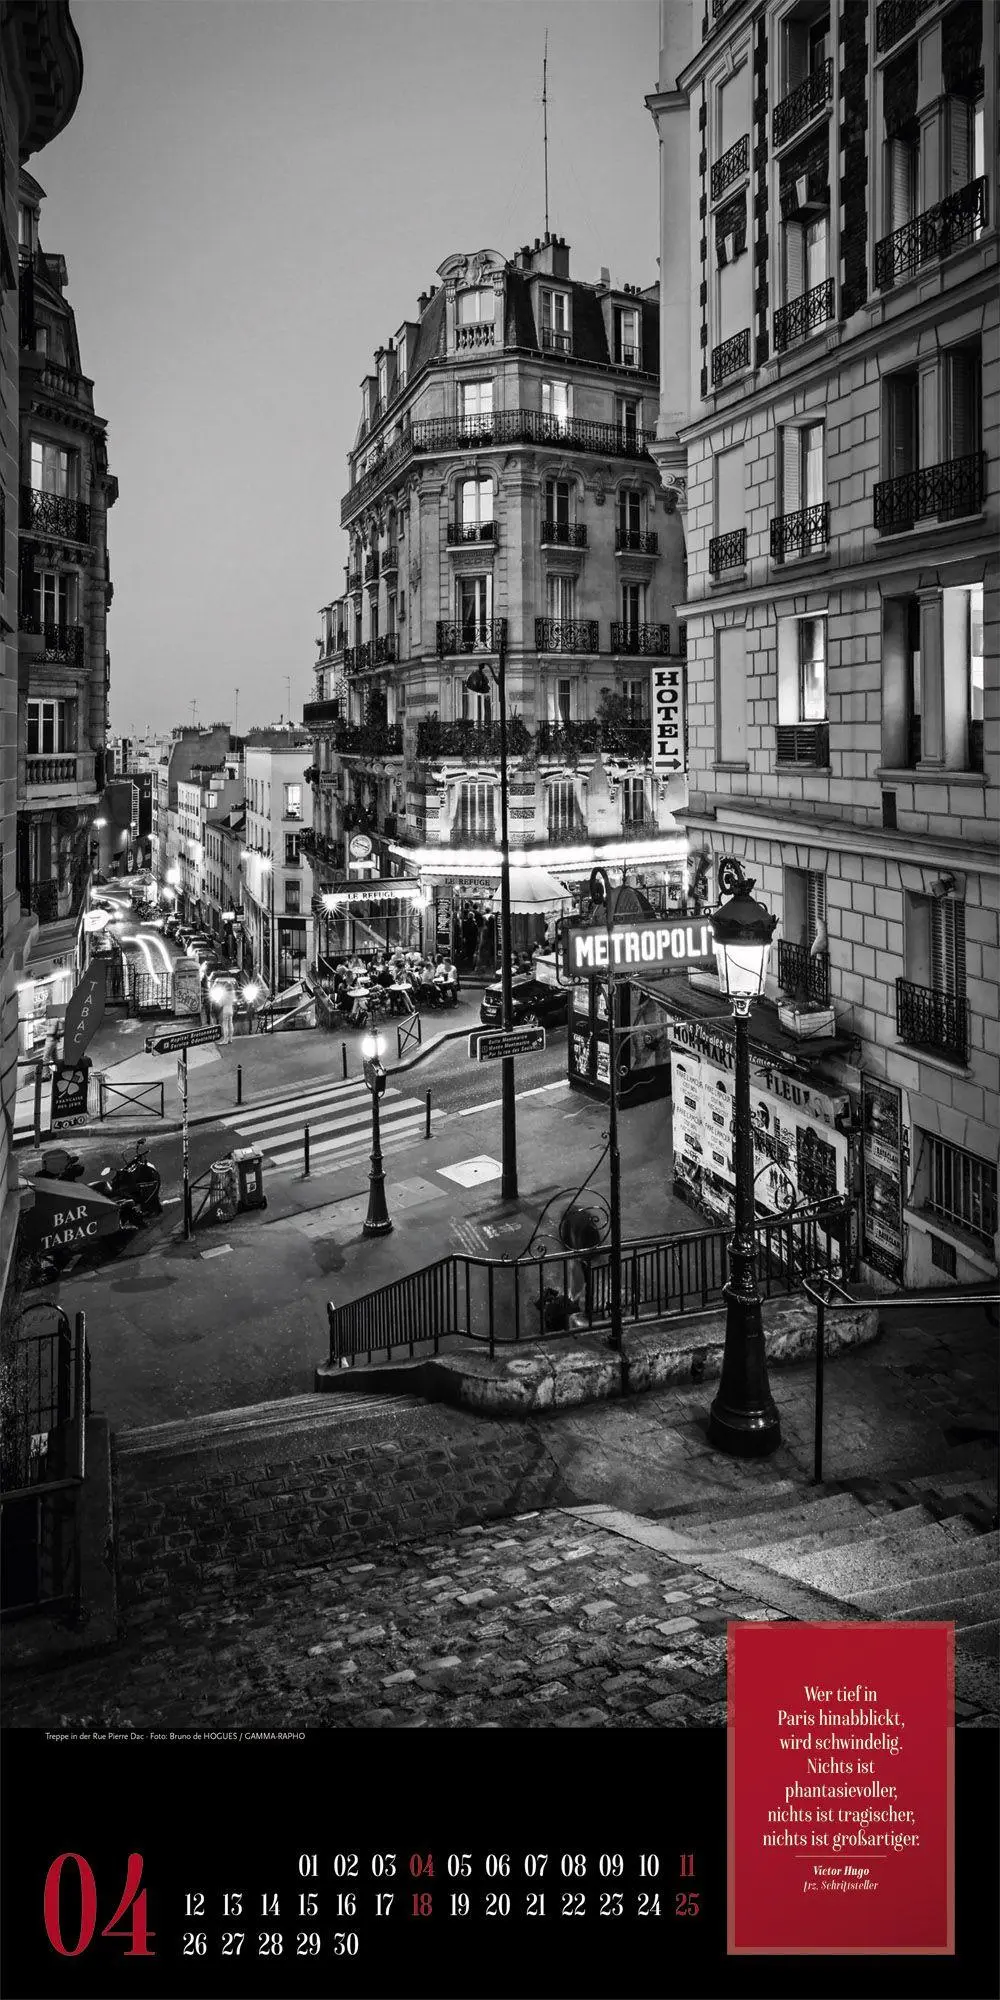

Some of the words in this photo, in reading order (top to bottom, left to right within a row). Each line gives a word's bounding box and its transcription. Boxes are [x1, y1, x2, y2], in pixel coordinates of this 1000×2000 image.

[654, 671, 679, 756] HOTEL
[444, 877, 453, 885] LE
[458, 878, 491, 886] REFUGE
[362, 891, 396, 900] REFUGE
[72, 981, 98, 1044] TABAC
[54, 1115, 85, 1129] LOTO
[53, 1205, 88, 1227] BAR
[41, 1221, 98, 1249] TABAC
